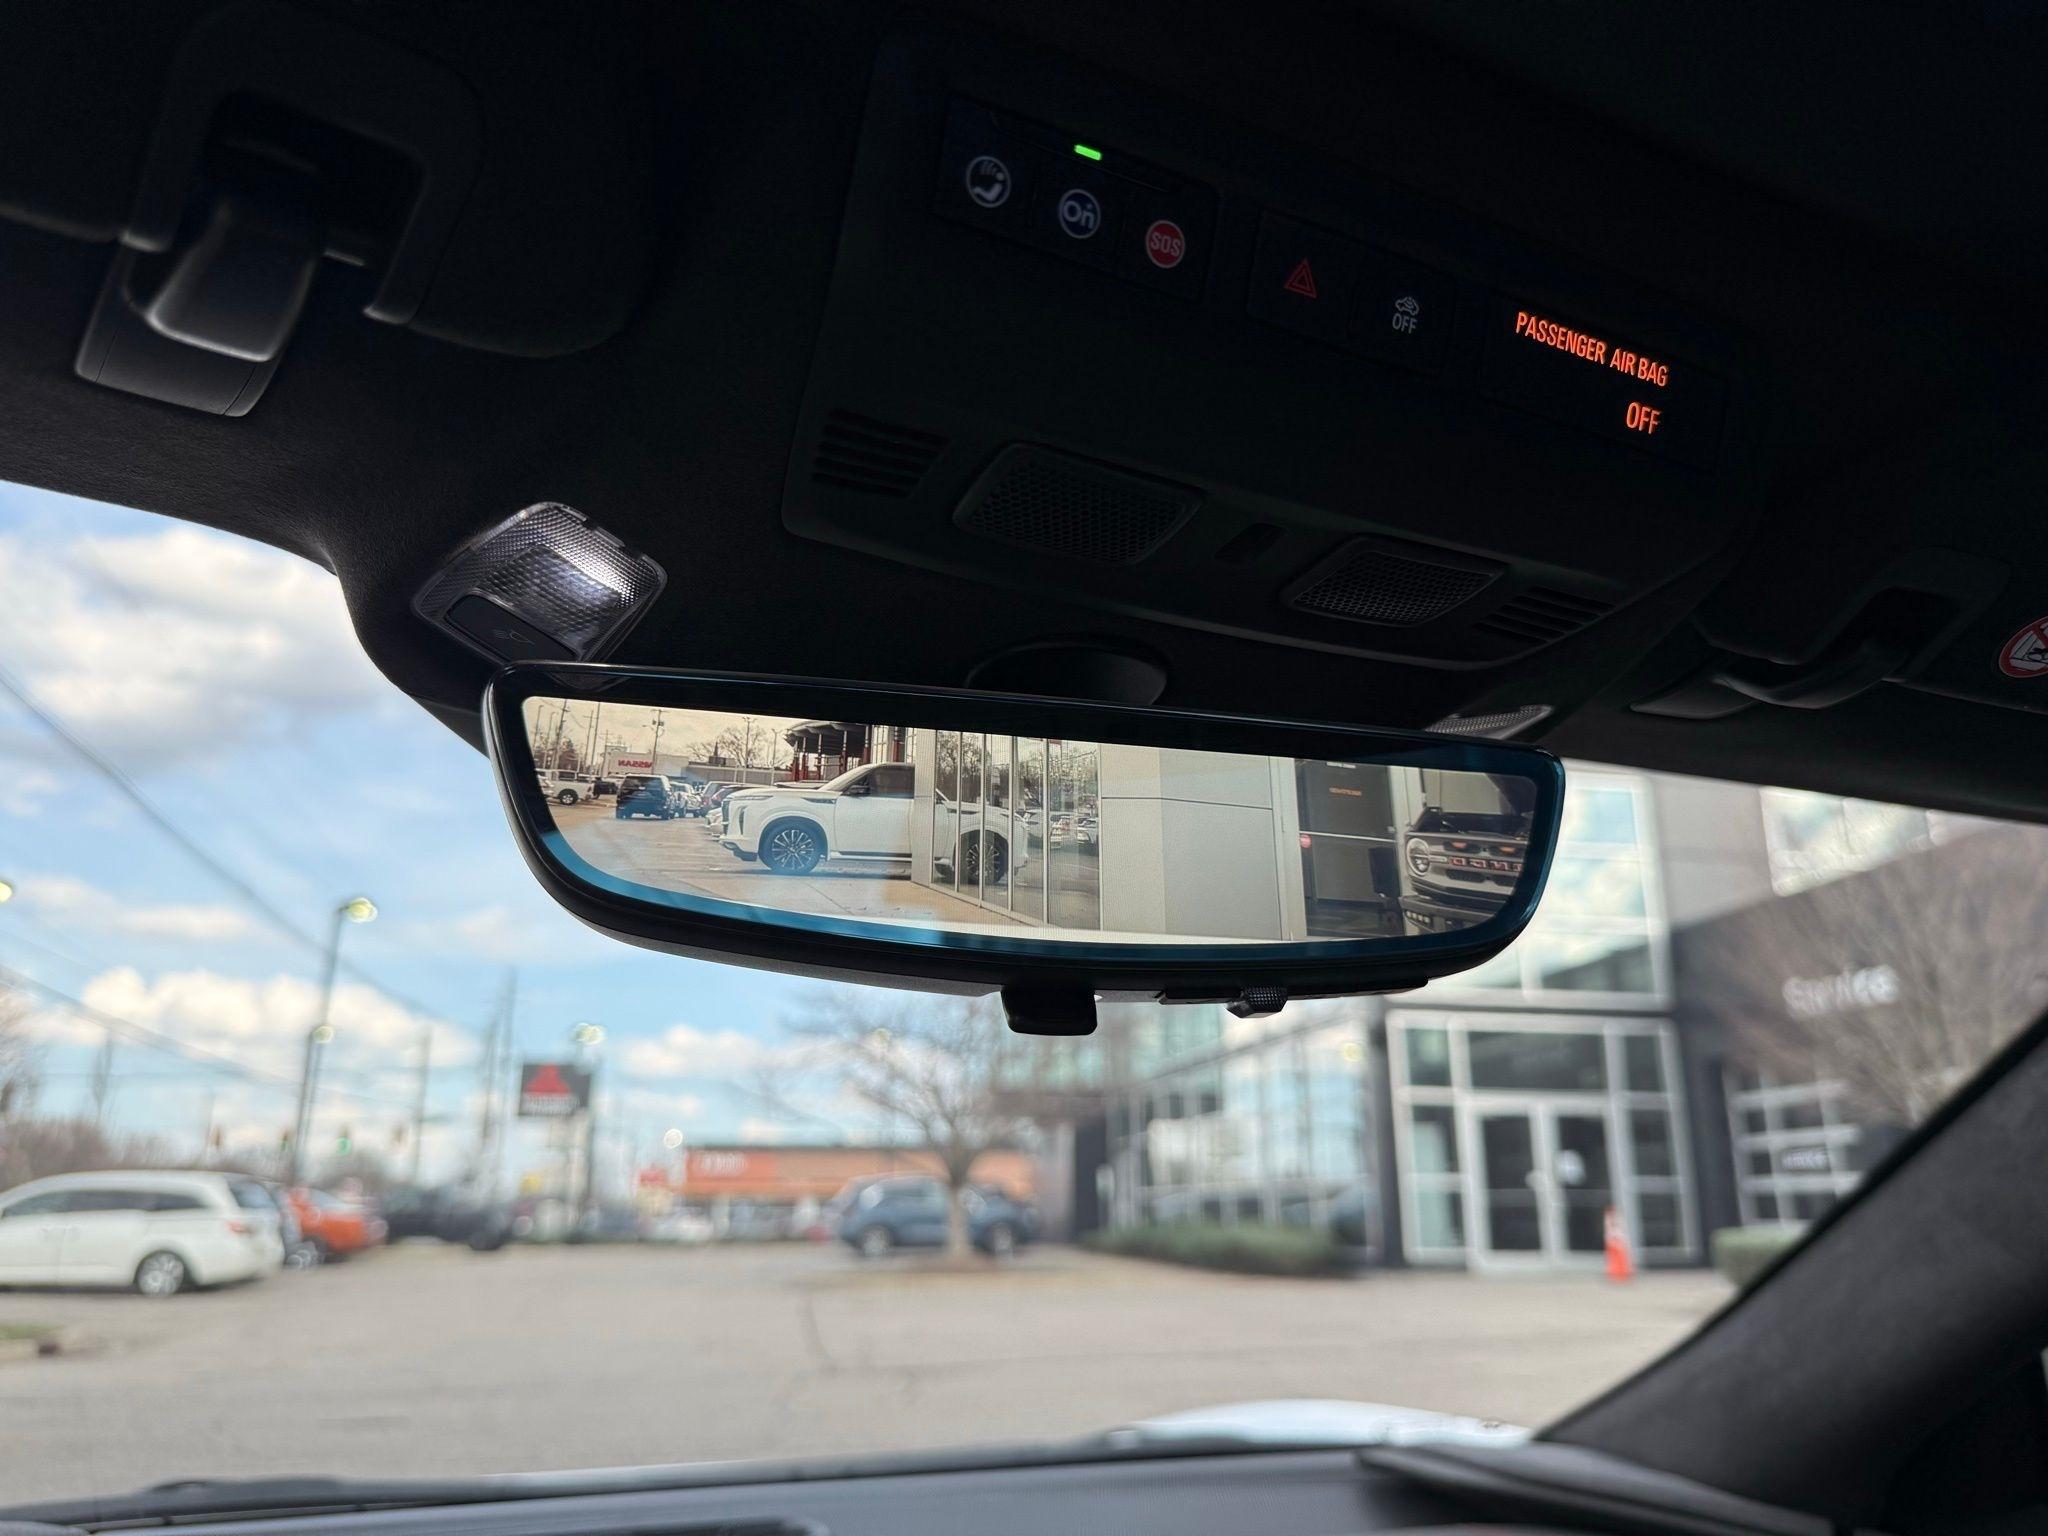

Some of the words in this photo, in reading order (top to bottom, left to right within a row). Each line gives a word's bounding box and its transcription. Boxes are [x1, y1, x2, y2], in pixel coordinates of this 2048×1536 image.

[1063, 200, 1095, 229] On
[1150, 232, 1182, 257] SOS
[1391, 313, 1418, 335] OFF
[1514, 310, 1608, 365] PASSENGER
[1625, 401, 1663, 434] OFF
